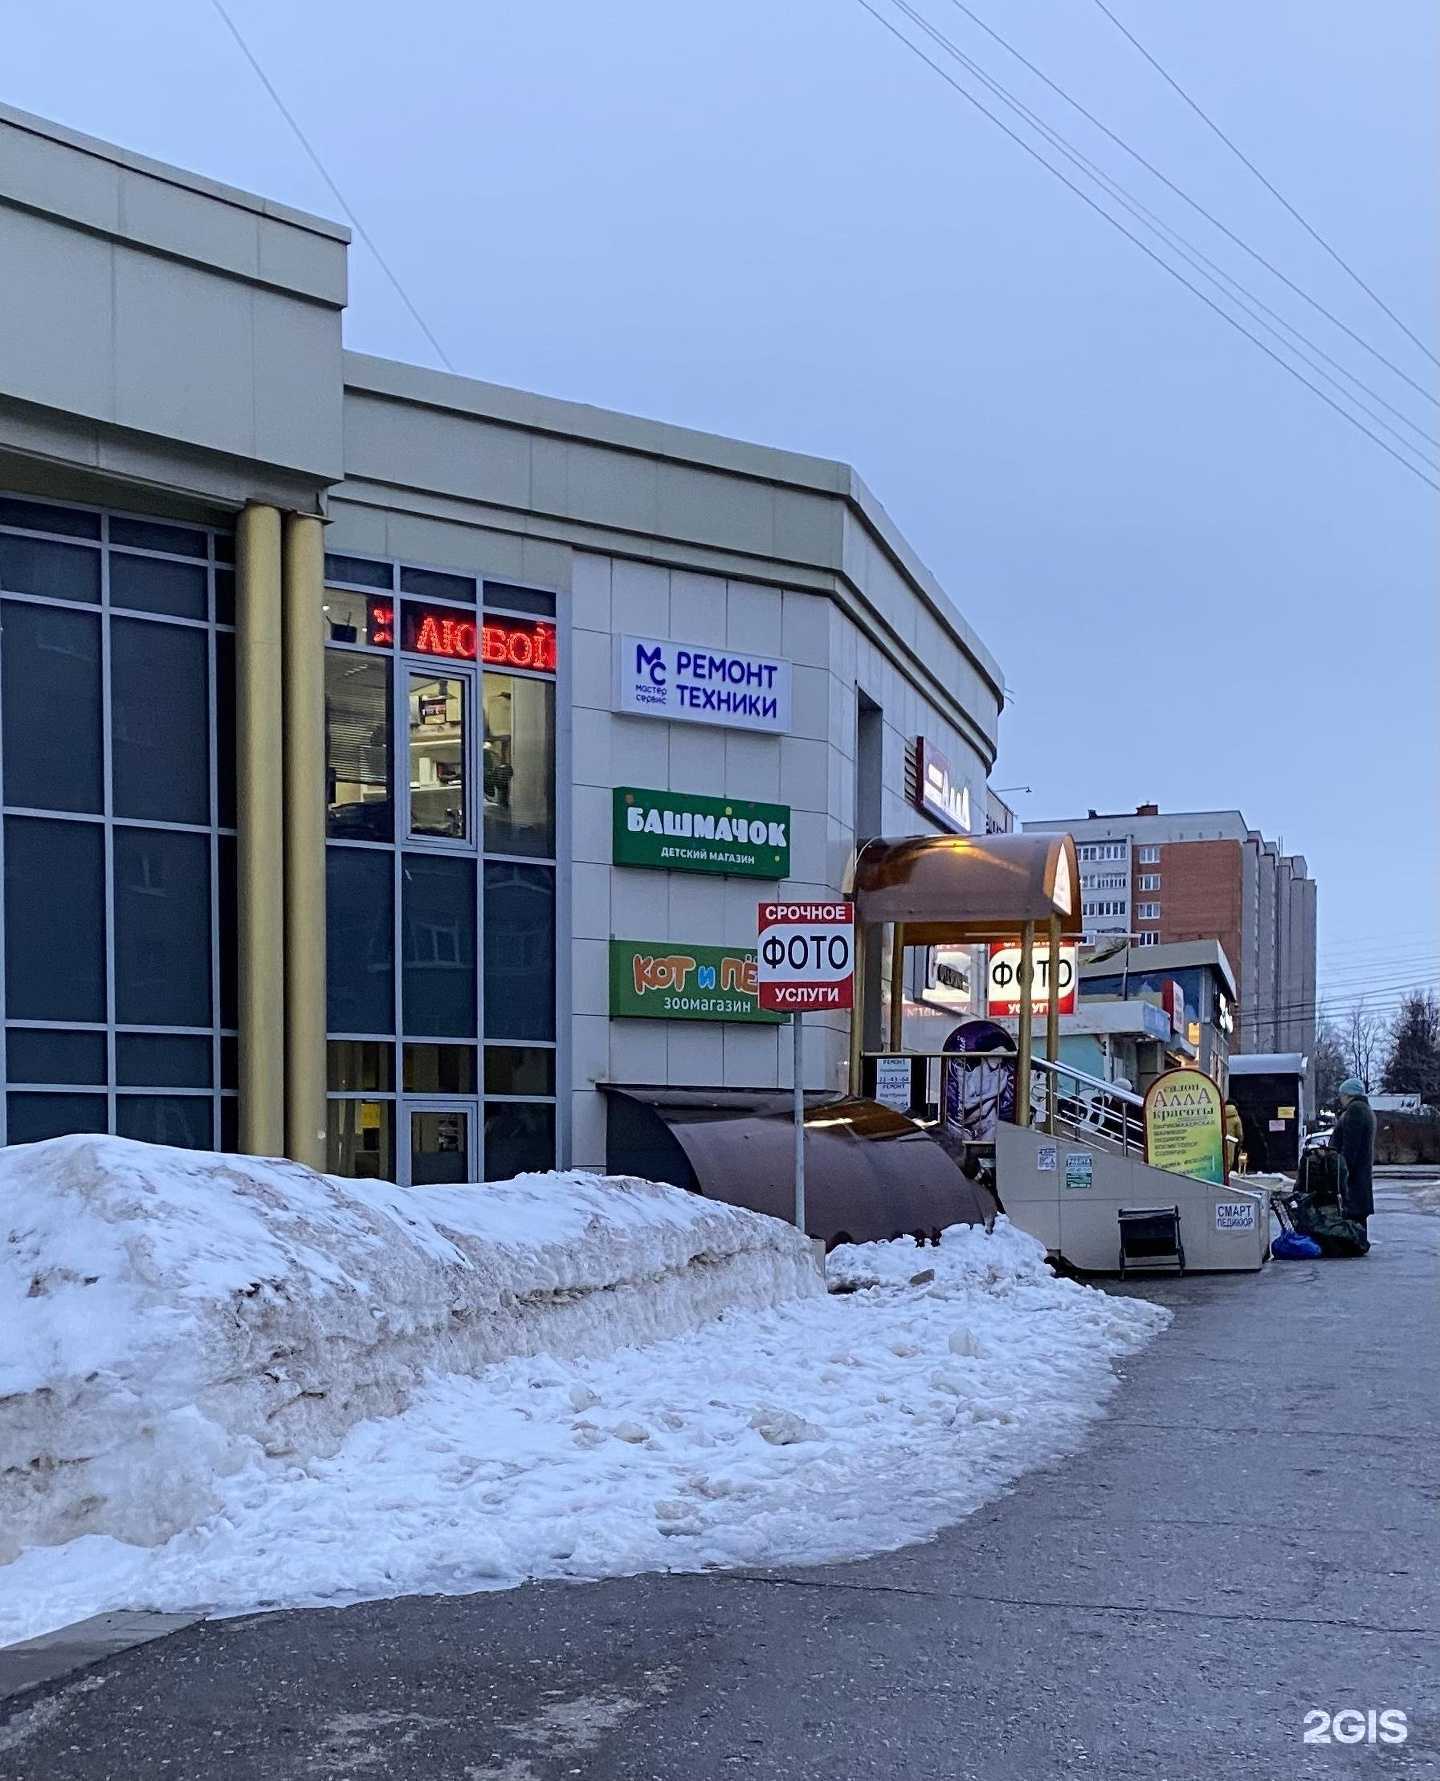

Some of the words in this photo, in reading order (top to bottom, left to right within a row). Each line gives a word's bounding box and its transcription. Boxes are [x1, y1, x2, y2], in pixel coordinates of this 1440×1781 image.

[676, 651, 778, 689] РЕМОНТ
[676, 684, 777, 718] ТЕХНИКИ
[626, 806, 787, 848] БАШМАЧОК
[661, 846, 708, 861] ДЕТСКИЙ
[709, 852, 755, 865] МАГАЗИН
[765, 905, 846, 920] СРОЧНОЕ
[762, 935, 849, 970] ФОТО
[632, 954, 696, 995] КОТ
[775, 987, 839, 1002] УСЛУГИ
[1217, 1205, 1252, 1217] СМАРТ
